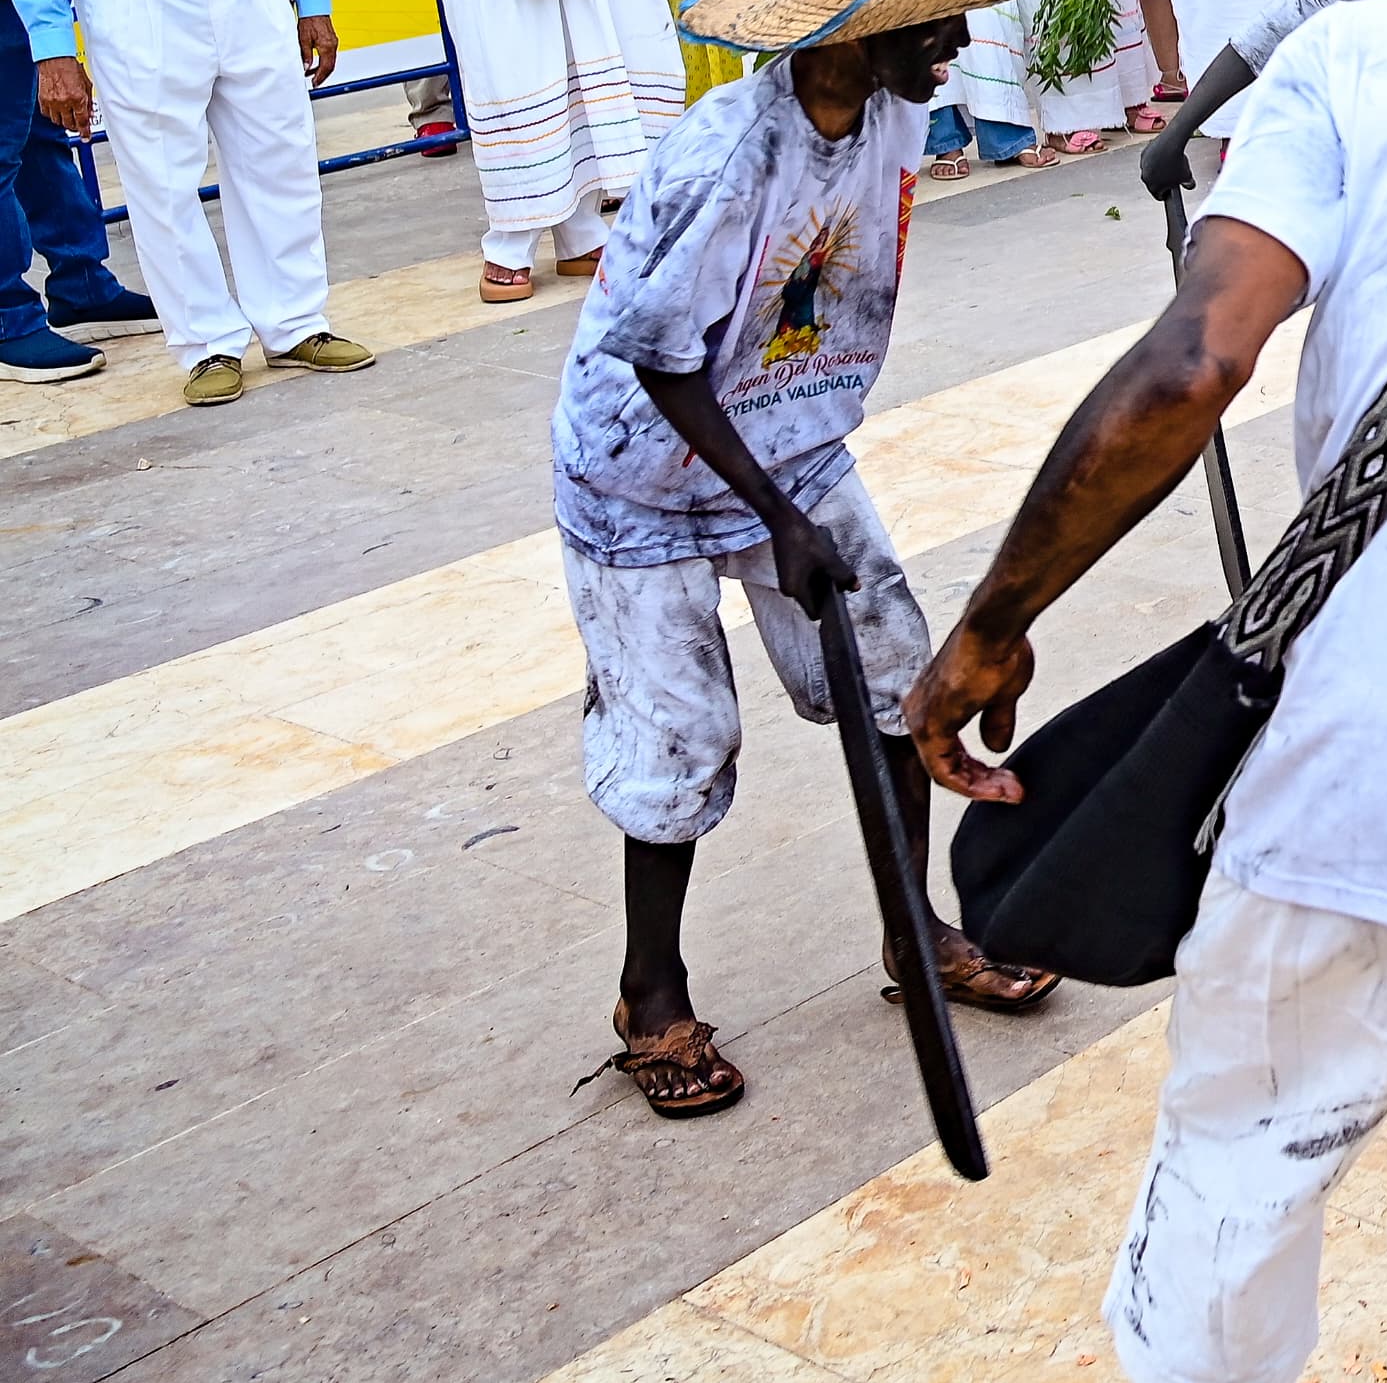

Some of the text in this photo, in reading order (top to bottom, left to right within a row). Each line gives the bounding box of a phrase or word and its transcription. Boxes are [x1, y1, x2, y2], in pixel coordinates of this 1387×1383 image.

[813, 350, 879, 377] Rosario
[722, 374, 864, 419] EYENDA VALLENATA
